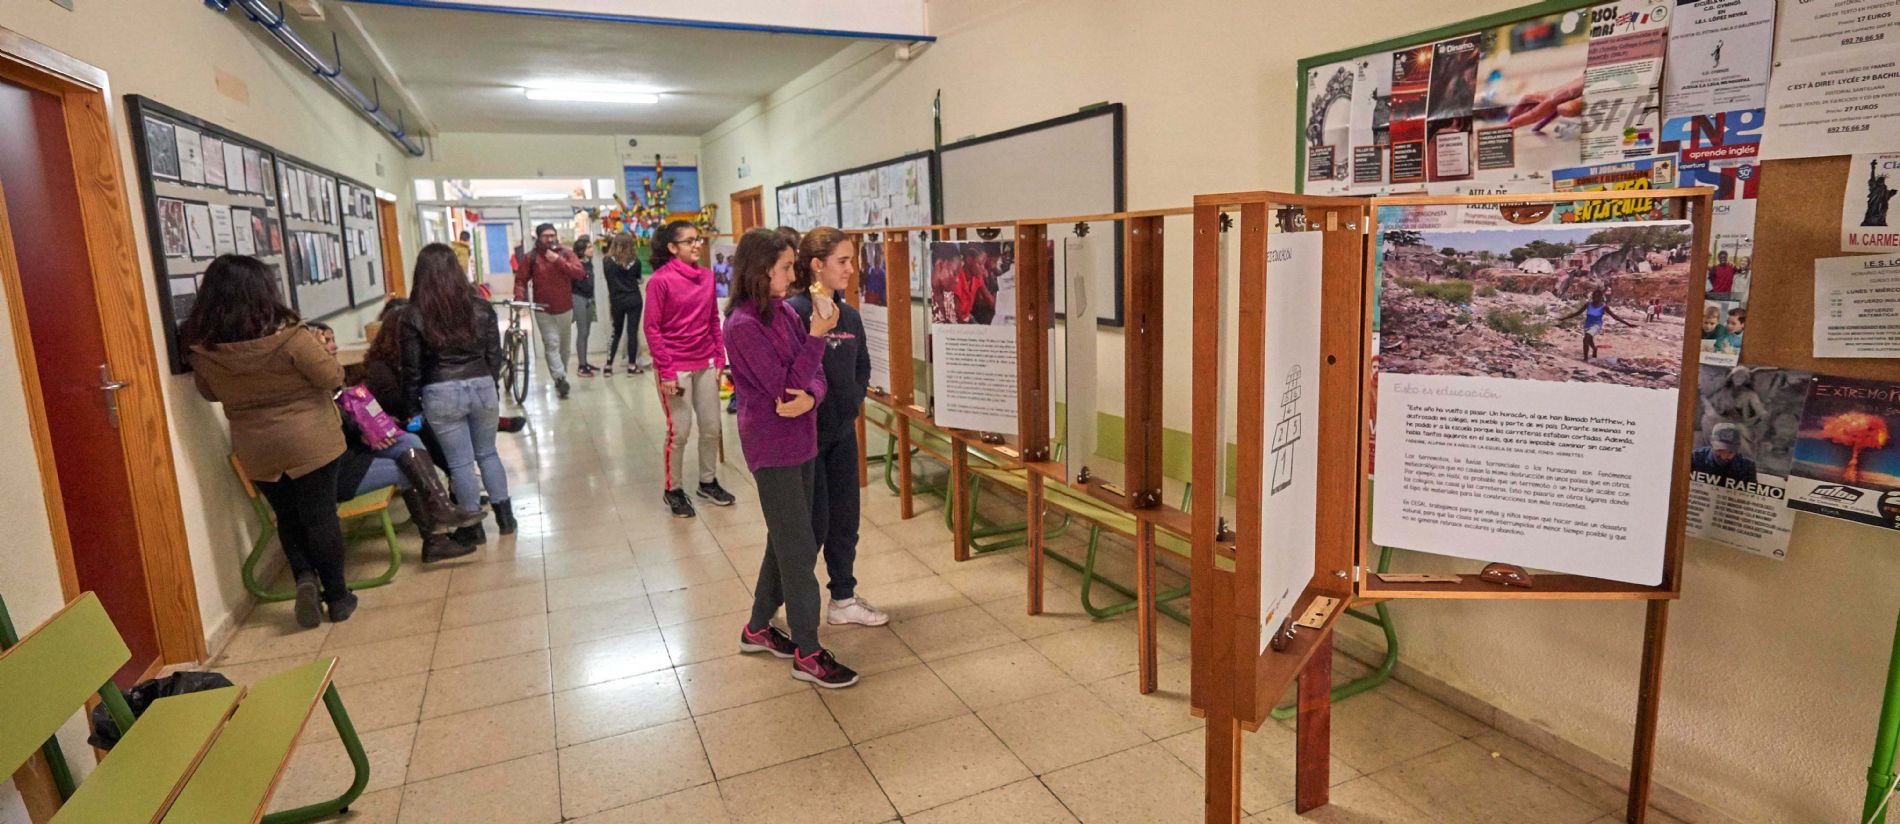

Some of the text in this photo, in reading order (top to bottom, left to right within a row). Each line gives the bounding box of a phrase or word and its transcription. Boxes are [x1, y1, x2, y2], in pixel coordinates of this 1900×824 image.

[1867, 12, 1892, 21] EUROS
[1854, 104, 1879, 112] EUROS
[1689, 145, 1756, 159] aprende inglés
[1612, 196, 1653, 217] CALLE
[1849, 233, 1860, 246] M.
[1394, 383, 1419, 395] Esto
[1422, 387, 1433, 396] es
[1480, 418, 1498, 426] pueblo
[1561, 423, 1589, 432] Durante
[1500, 411, 1529, 420] huracán,
[1564, 415, 1589, 423] llamado
[1590, 417, 1625, 426] Matthew,
[1278, 428, 1284, 443] 2
[1423, 430, 1442, 438] tantos
[1505, 429, 1541, 437] carreteras
[1605, 436, 1635, 445] Además,
[1281, 448, 1287, 476] 1
[1510, 471, 1544, 480] destrucción
[1570, 477, 1588, 485] países
[1546, 466, 1632, 480] huracanes fenómenos
[1471, 475, 1496, 483] probable
[1520, 481, 1551, 489] terremoto
[1569, 485, 1594, 493] huracán
[1690, 470, 1783, 500] NEW RAEMO
[1483, 493, 1526, 503] construcciones
[1585, 495, 1607, 504] lugares
[1610, 498, 1629, 506] donde
[1554, 517, 1627, 532] hacer desastre
[1564, 527, 1584, 536] tiempo
